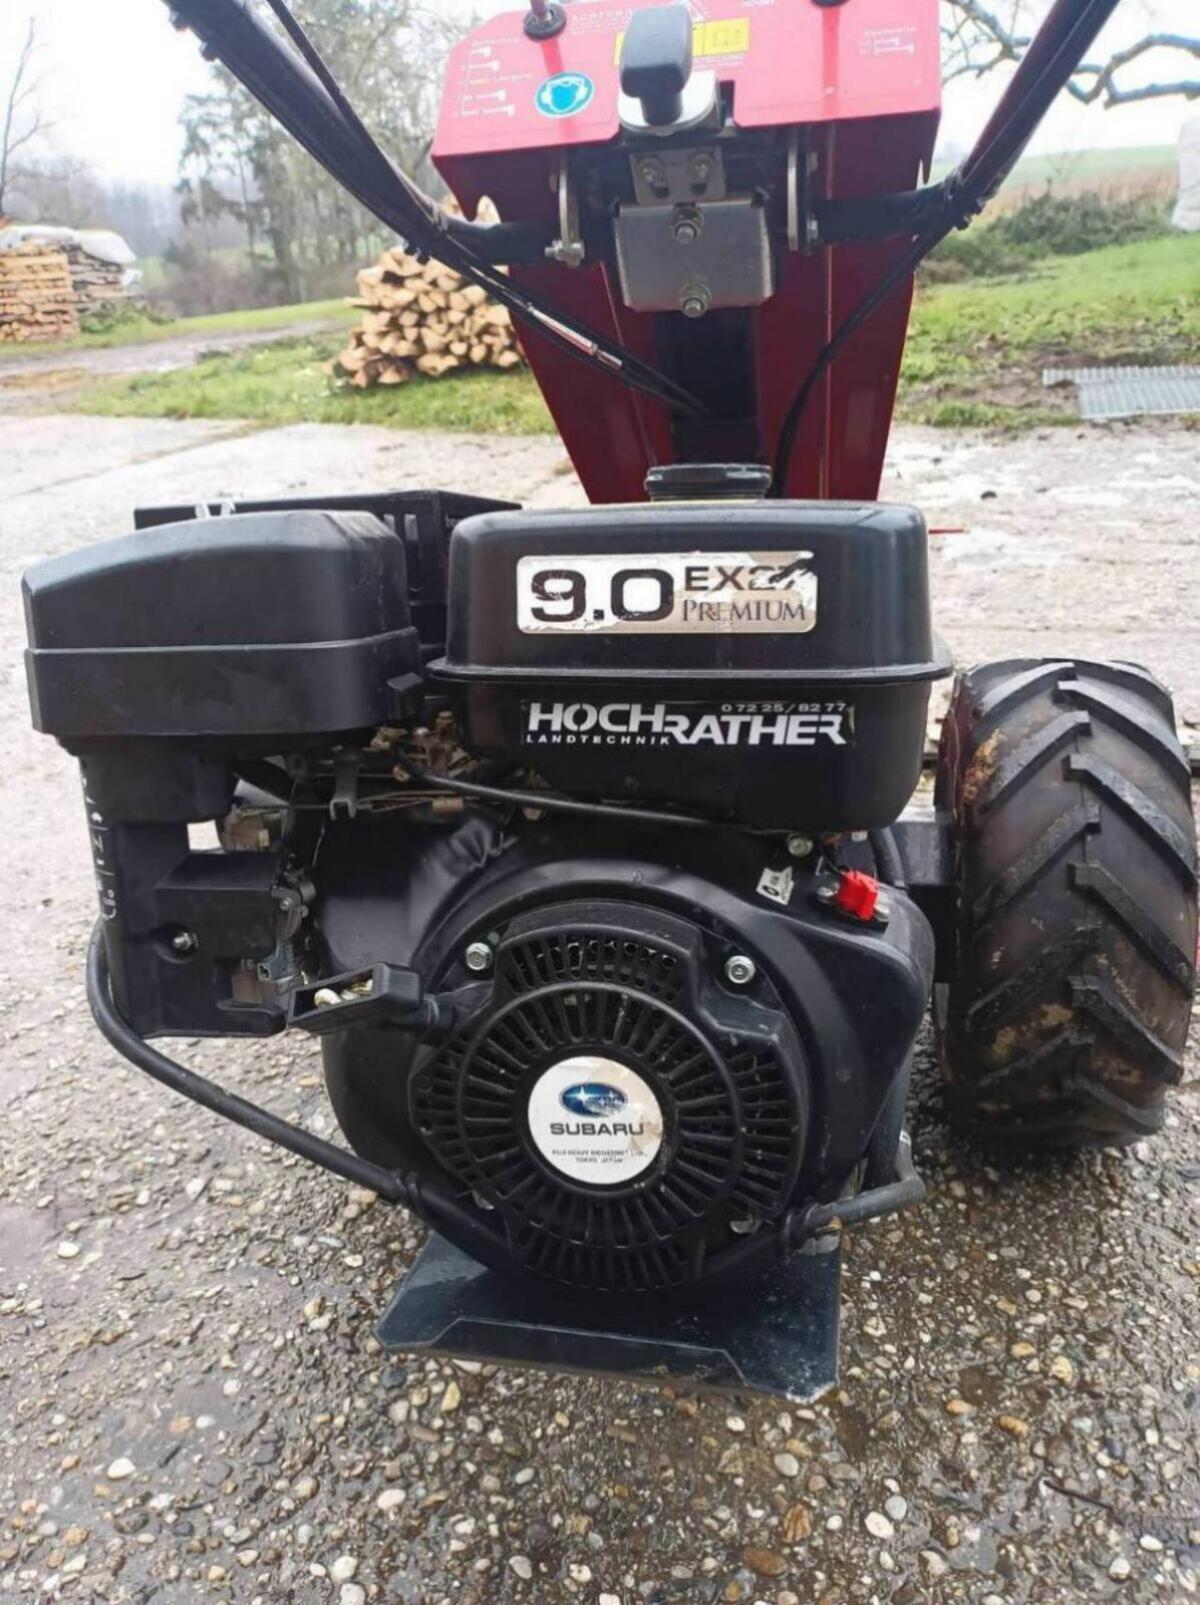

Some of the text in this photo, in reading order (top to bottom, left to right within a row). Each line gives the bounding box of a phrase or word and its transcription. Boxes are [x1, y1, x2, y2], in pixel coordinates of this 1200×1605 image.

[530, 568, 675, 623] 9.0
[683, 599, 805, 622] PREMIUM
[526, 734, 670, 745] LANDTECHNIK
[550, 1122, 644, 1136] SUBARU
